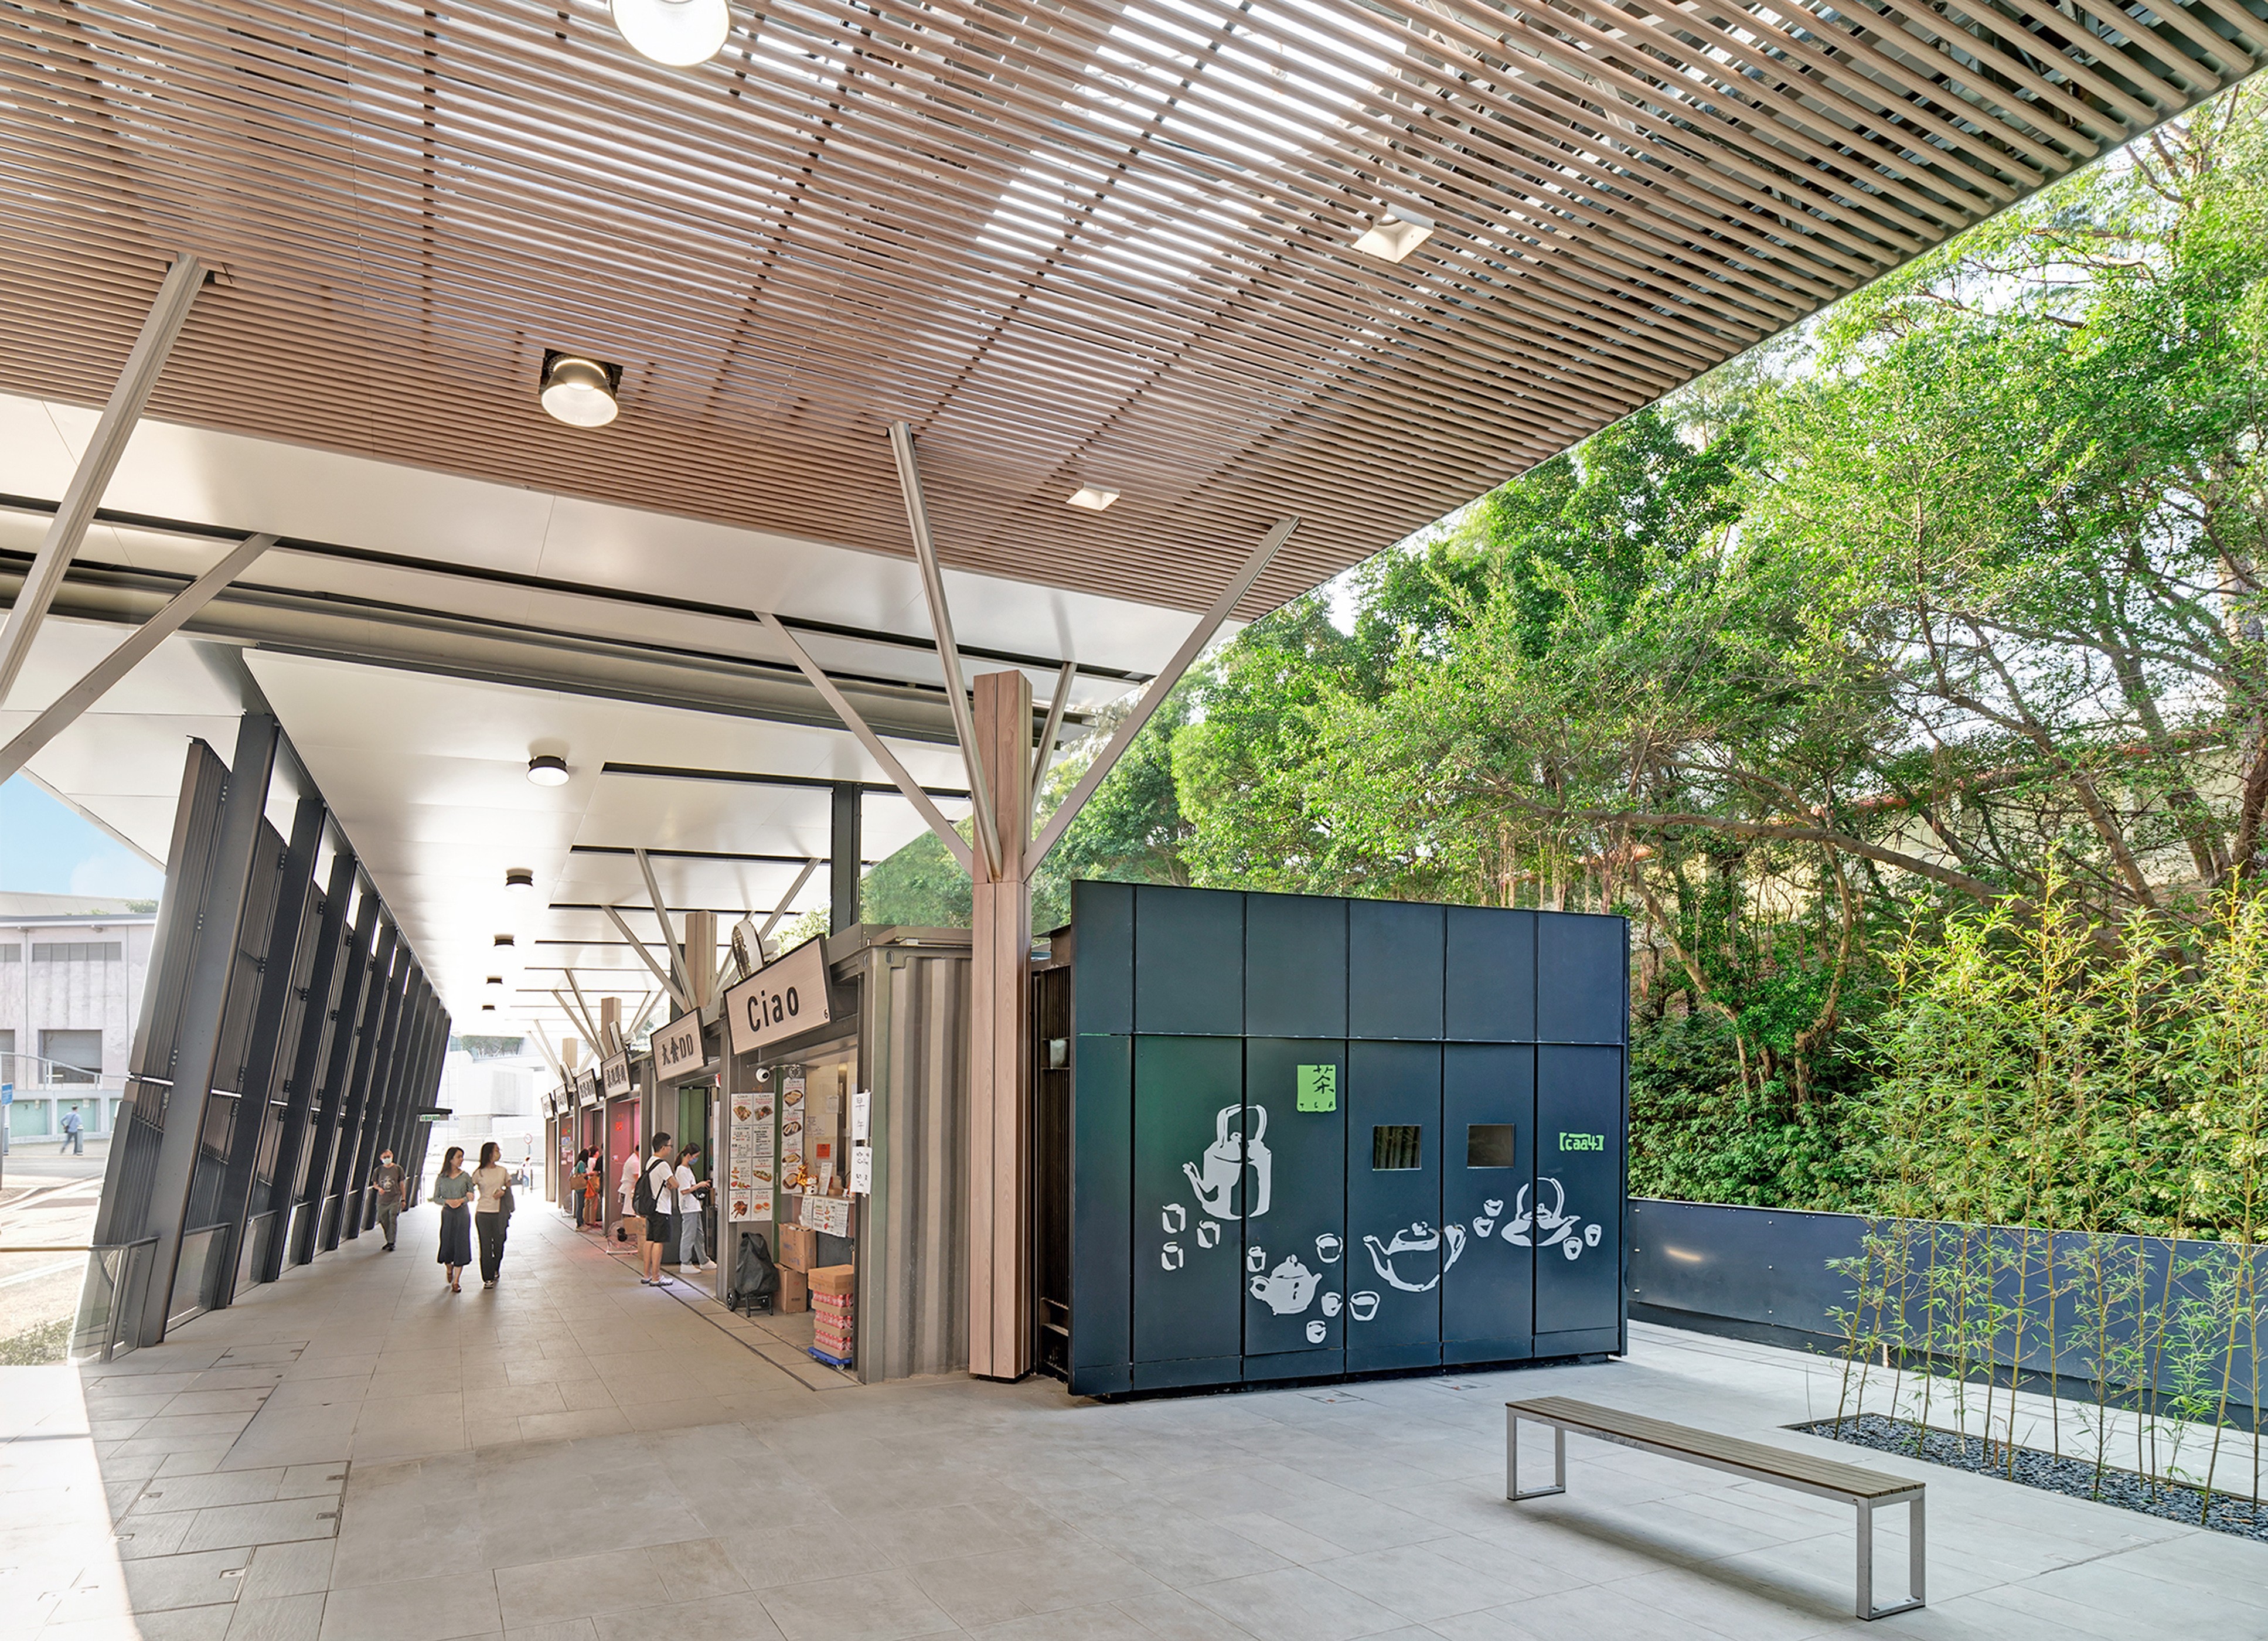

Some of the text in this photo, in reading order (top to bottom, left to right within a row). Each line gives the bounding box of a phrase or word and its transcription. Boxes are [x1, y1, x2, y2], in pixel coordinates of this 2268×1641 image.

[747, 986, 799, 1032] Ciao
[823, 1009, 829, 1019] 6
[1313, 1065, 1334, 1094] 茶
